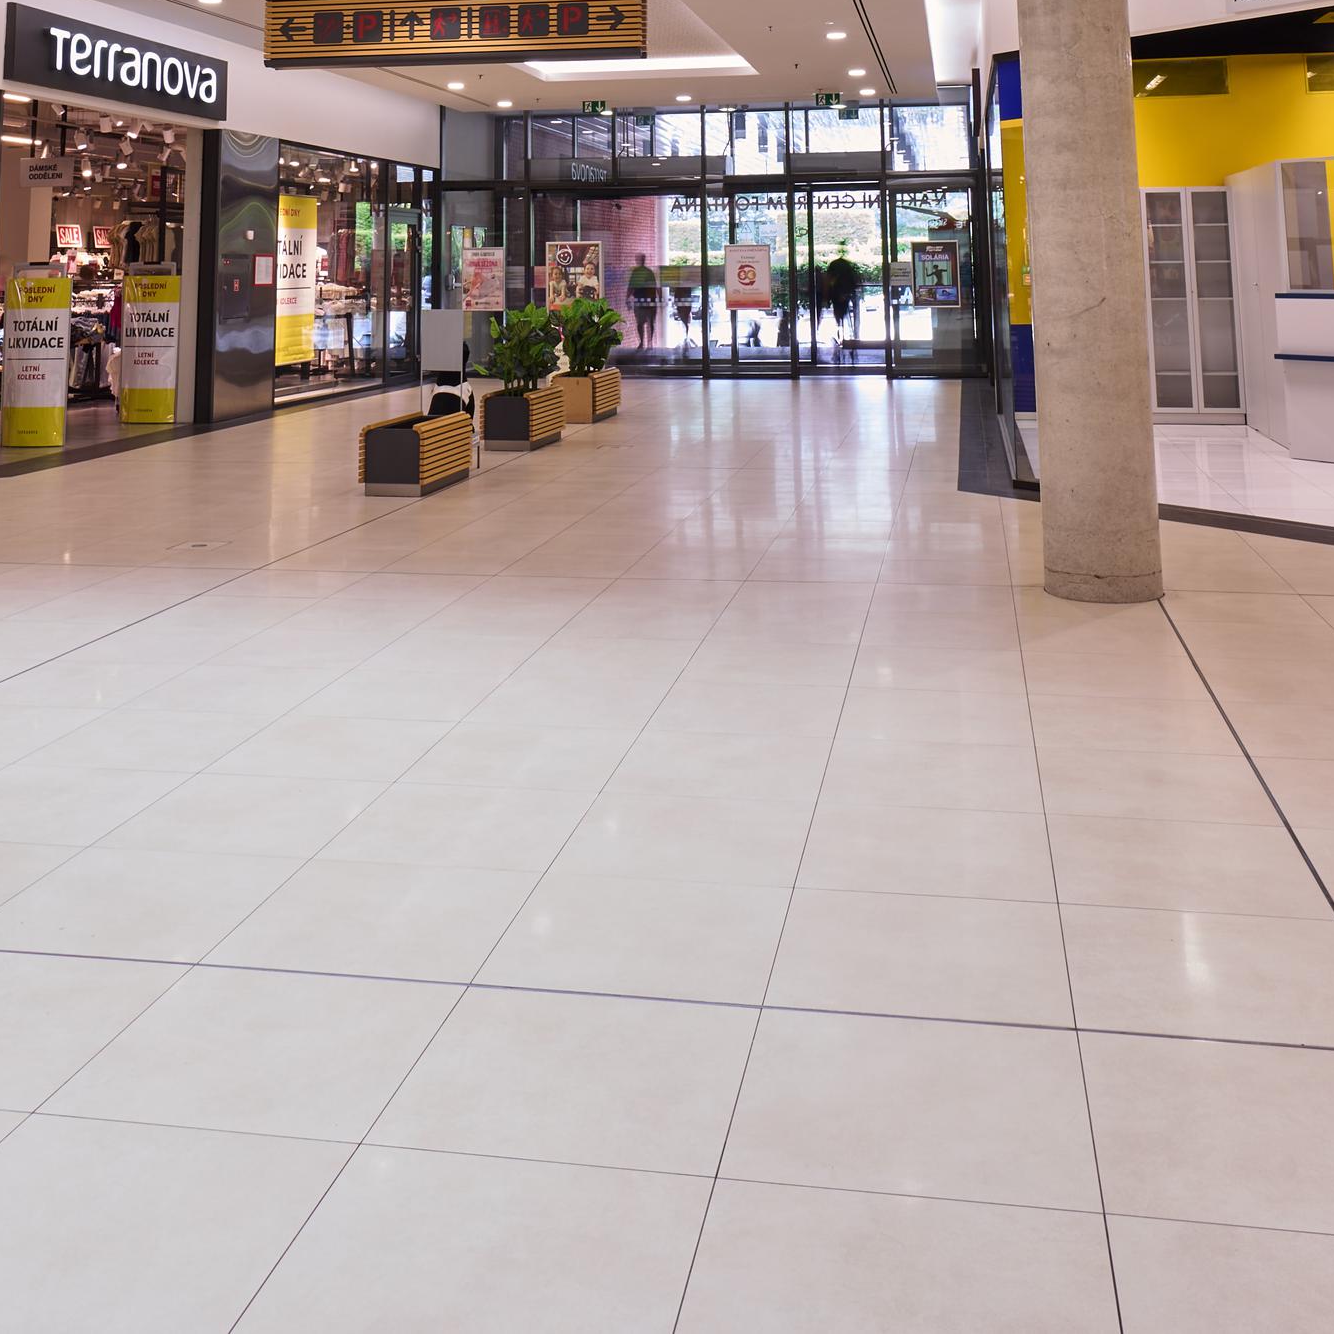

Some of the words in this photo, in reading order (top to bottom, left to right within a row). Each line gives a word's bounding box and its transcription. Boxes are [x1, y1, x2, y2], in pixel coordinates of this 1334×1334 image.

[50, 27, 217, 104] Terranova
[60, 227, 79, 244] SALE
[276, 264, 307, 279] IDACE
[28, 295, 44, 303] DNY
[129, 310, 170, 323] TOTÁLNÍ
[13, 316, 59, 332] TOTÁLNÍ
[125, 327, 174, 338] LIKVIDACE
[8, 337, 64, 349] LIKVIDACE
